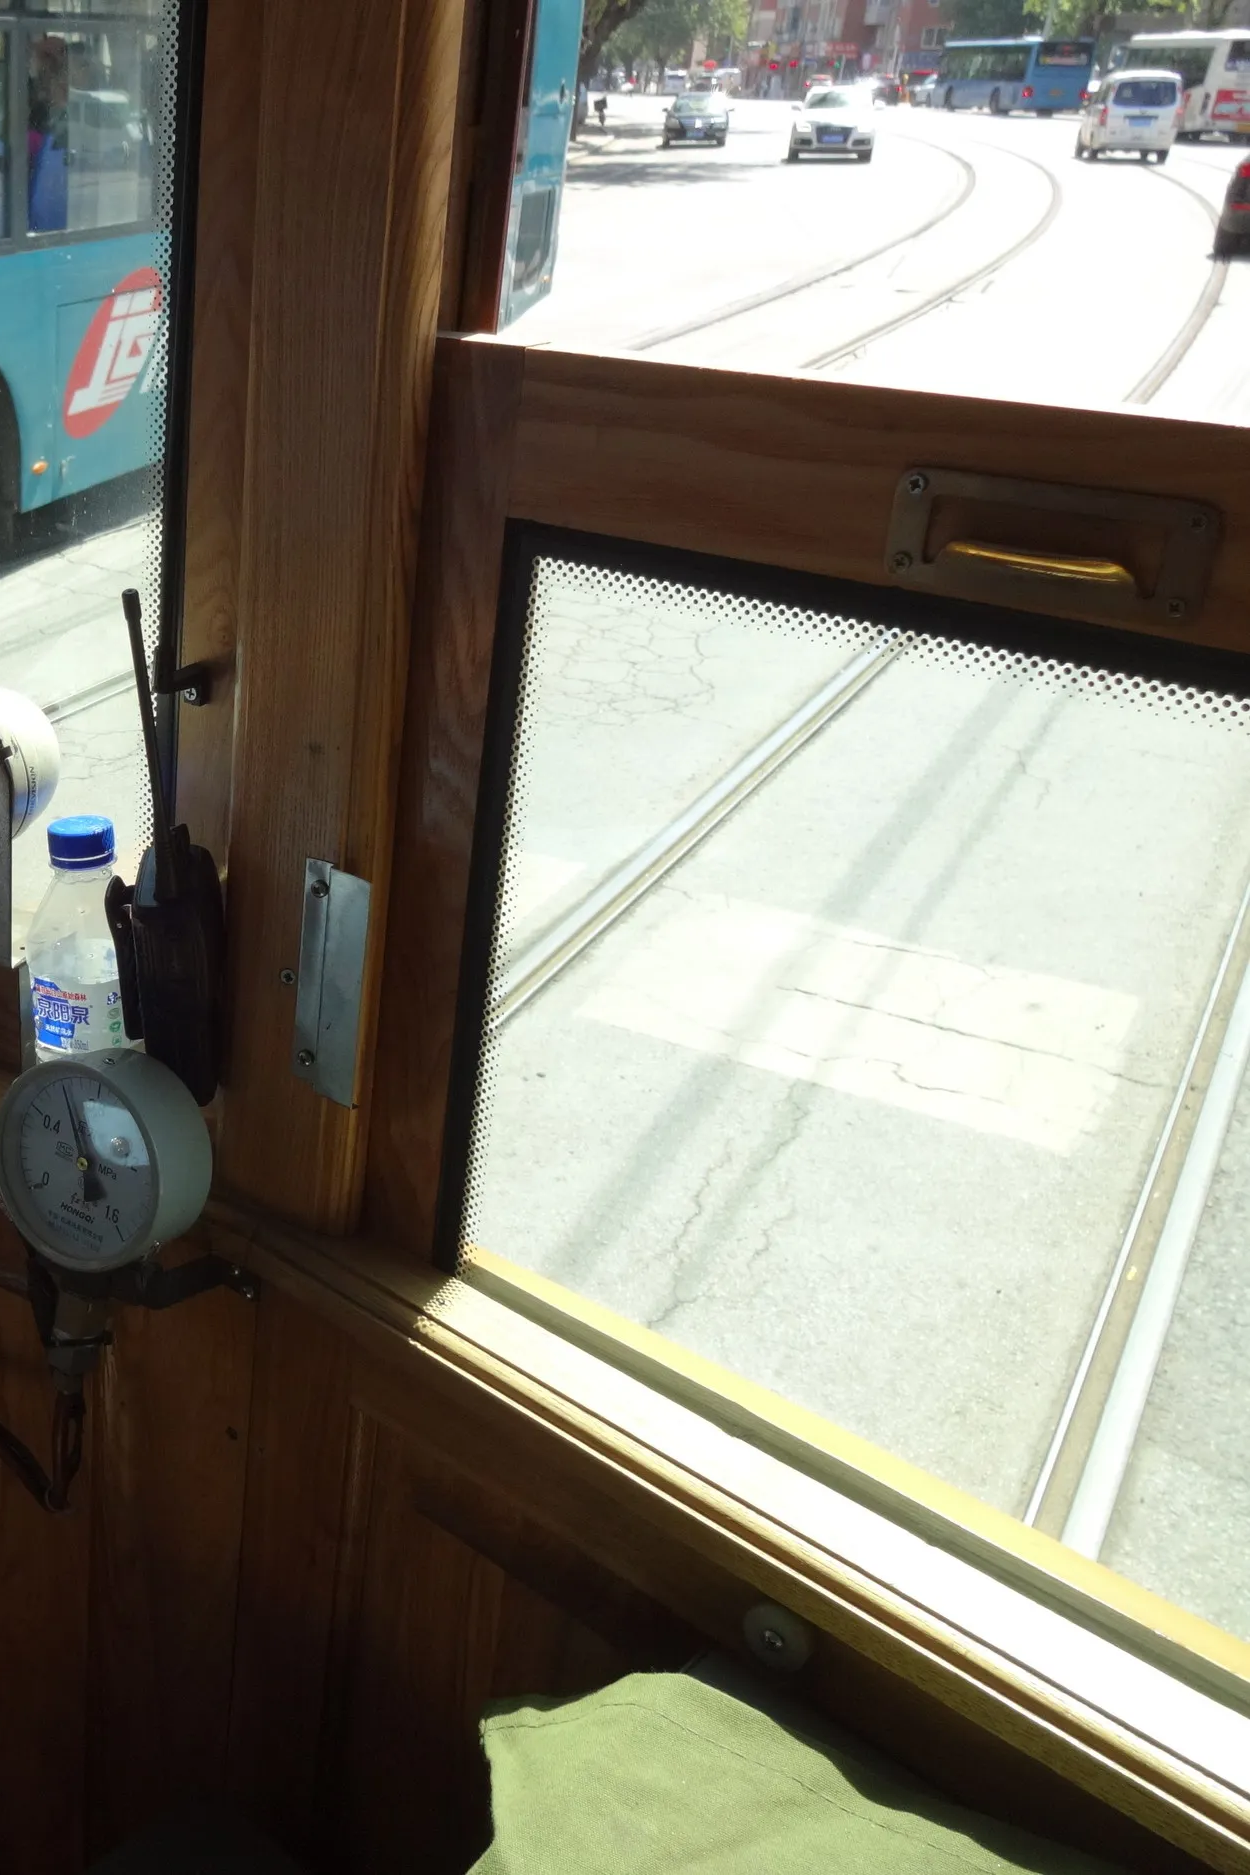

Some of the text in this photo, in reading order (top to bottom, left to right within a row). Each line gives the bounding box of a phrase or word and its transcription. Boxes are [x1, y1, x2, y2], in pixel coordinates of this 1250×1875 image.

[37, 999, 90, 1025] 泉阳泉
[43, 1115, 60, 1134] 0.4
[42, 1171, 49, 1186] 0
[98, 1164, 117, 1180] MPa
[105, 1205, 119, 1224] 1.6
